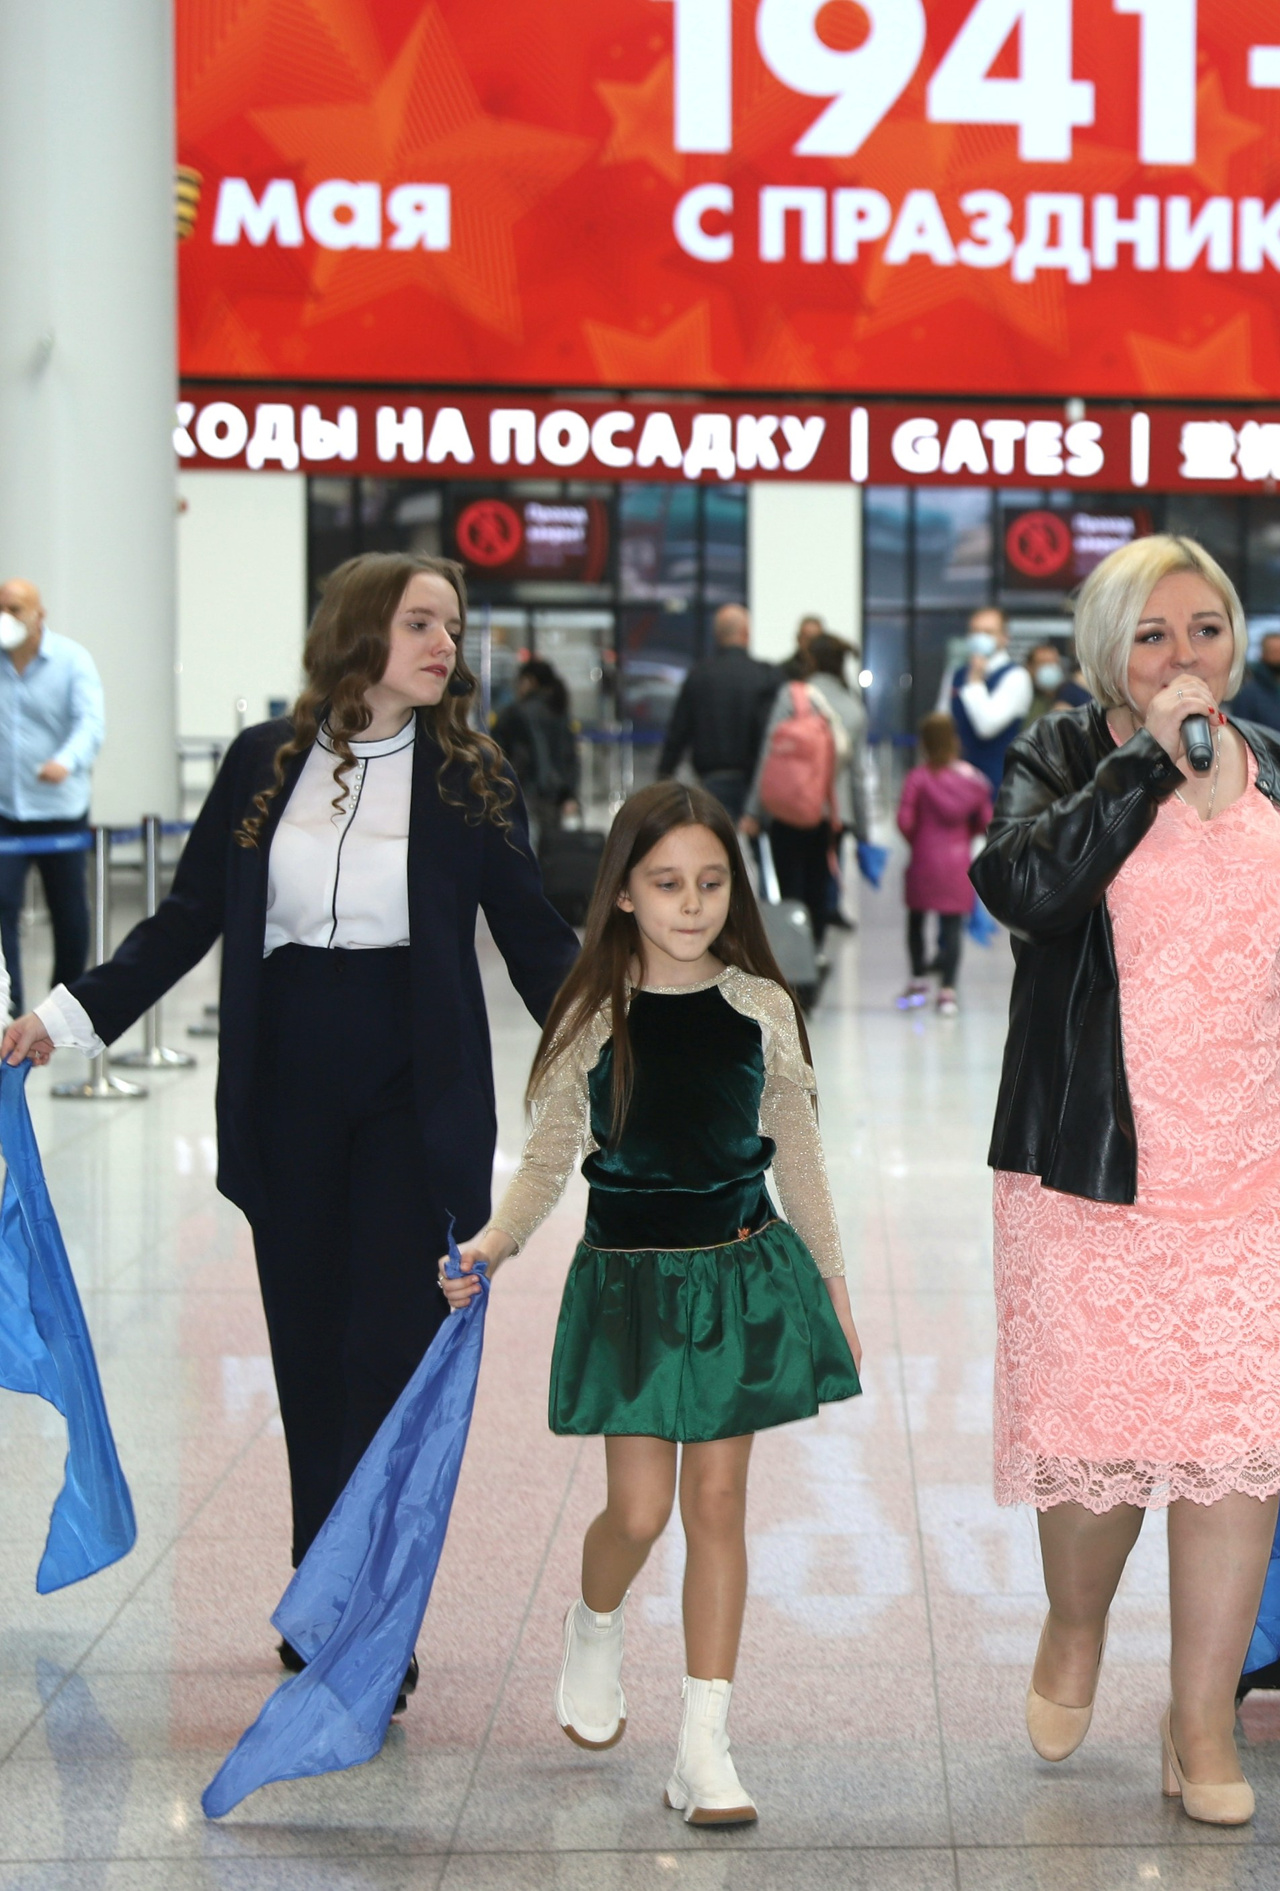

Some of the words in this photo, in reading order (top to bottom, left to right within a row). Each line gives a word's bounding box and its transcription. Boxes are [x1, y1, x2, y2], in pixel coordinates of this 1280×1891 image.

[673, 182, 734, 263] С
[375, 406, 475, 465] НА
[488, 408, 827, 479] ПОСАДКУ
[891, 416, 1105, 477] GATES
